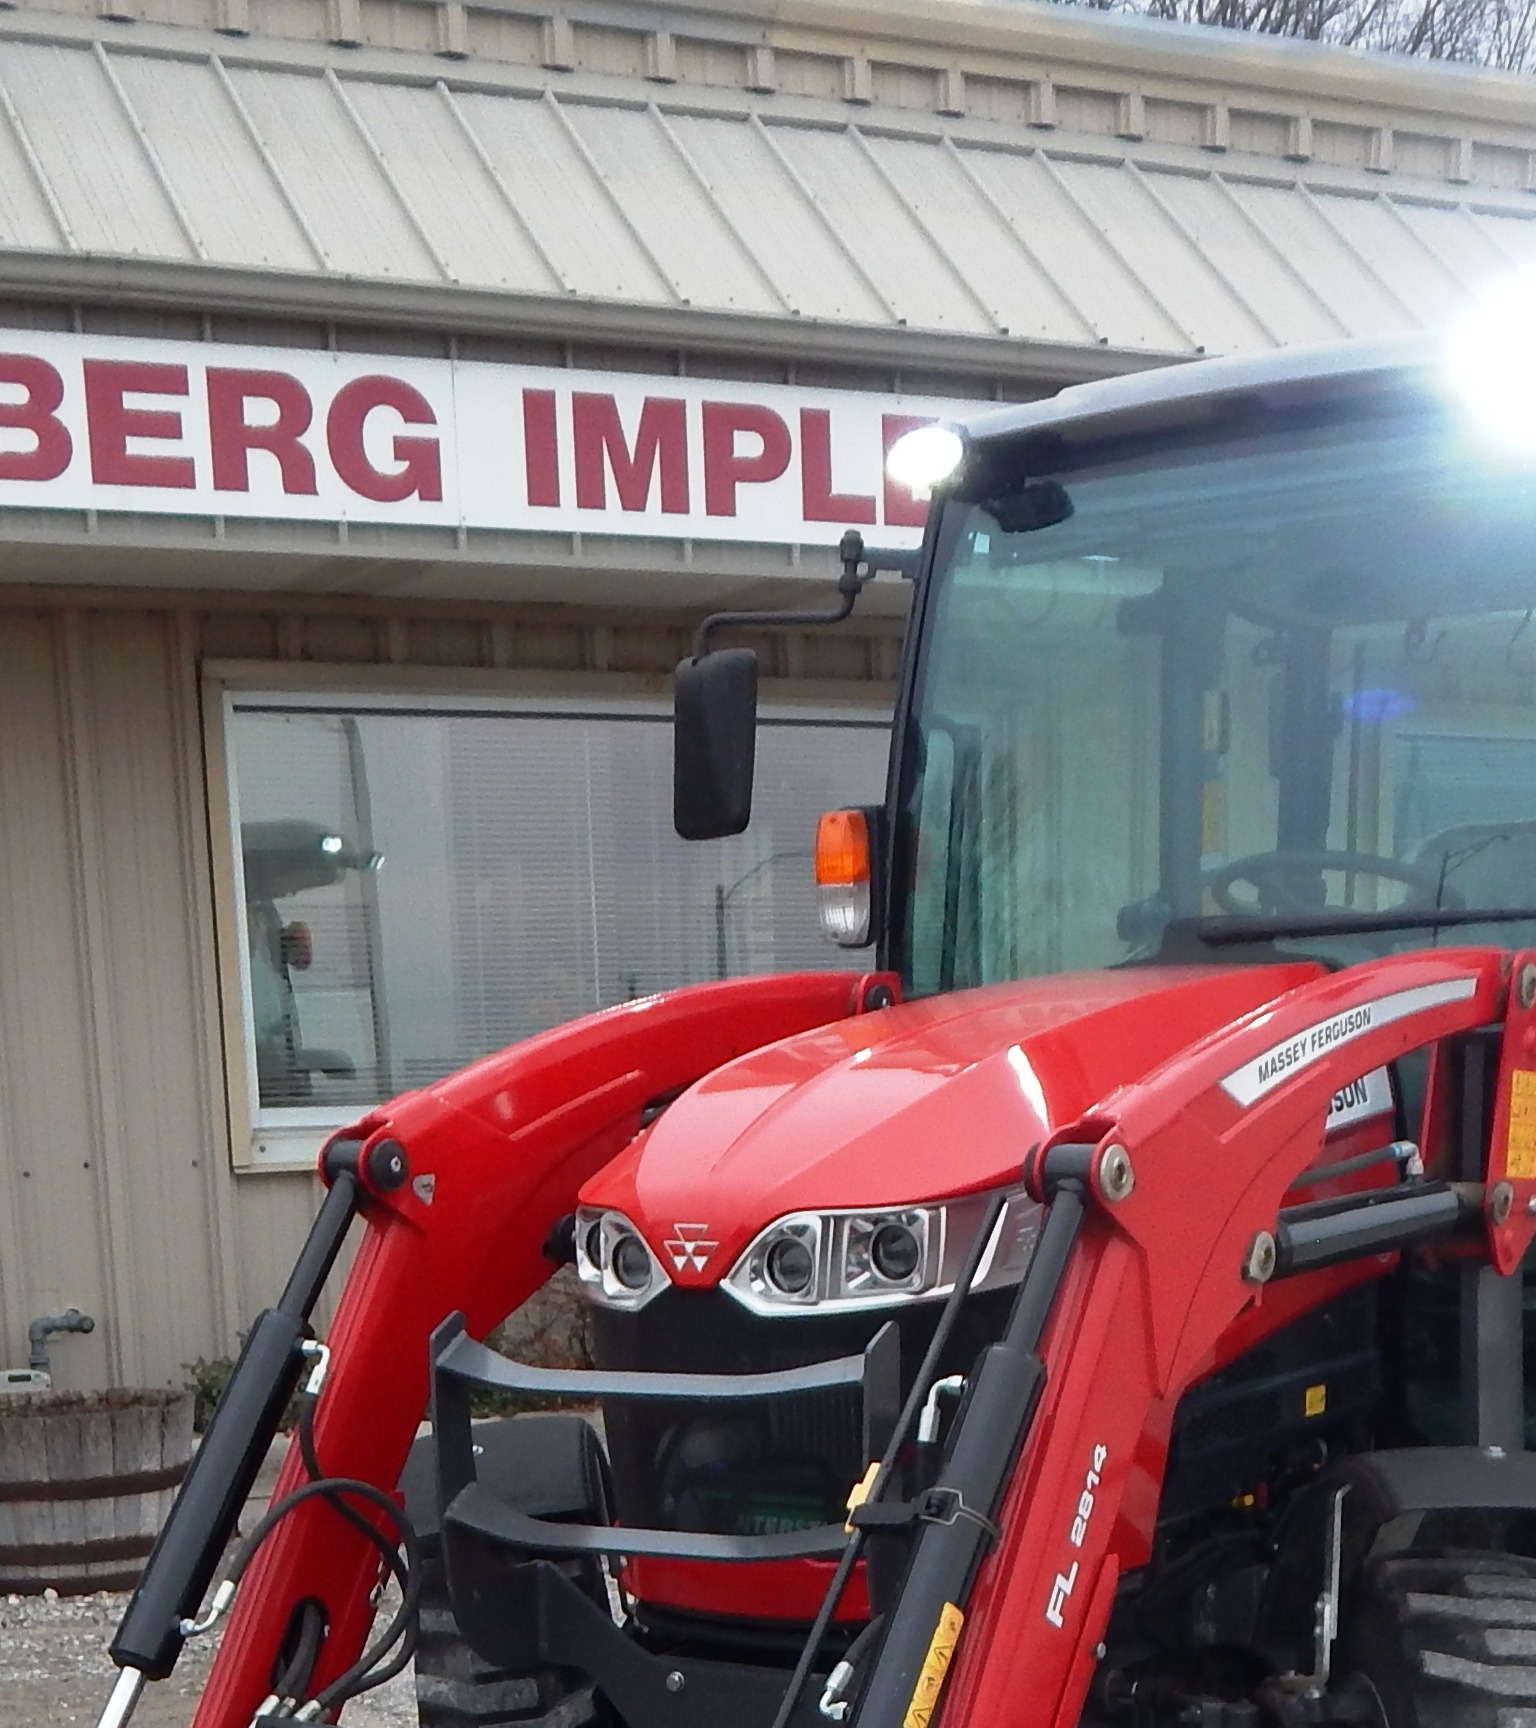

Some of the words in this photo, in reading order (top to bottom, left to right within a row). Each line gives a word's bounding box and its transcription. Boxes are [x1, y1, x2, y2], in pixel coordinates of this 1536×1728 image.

[1258, 1035, 1309, 1085] MASSEY
[1310, 1006, 1373, 1051] FERGUSON
[1045, 1560, 1080, 1629] FL
[1070, 1442, 1109, 1549] 2814
